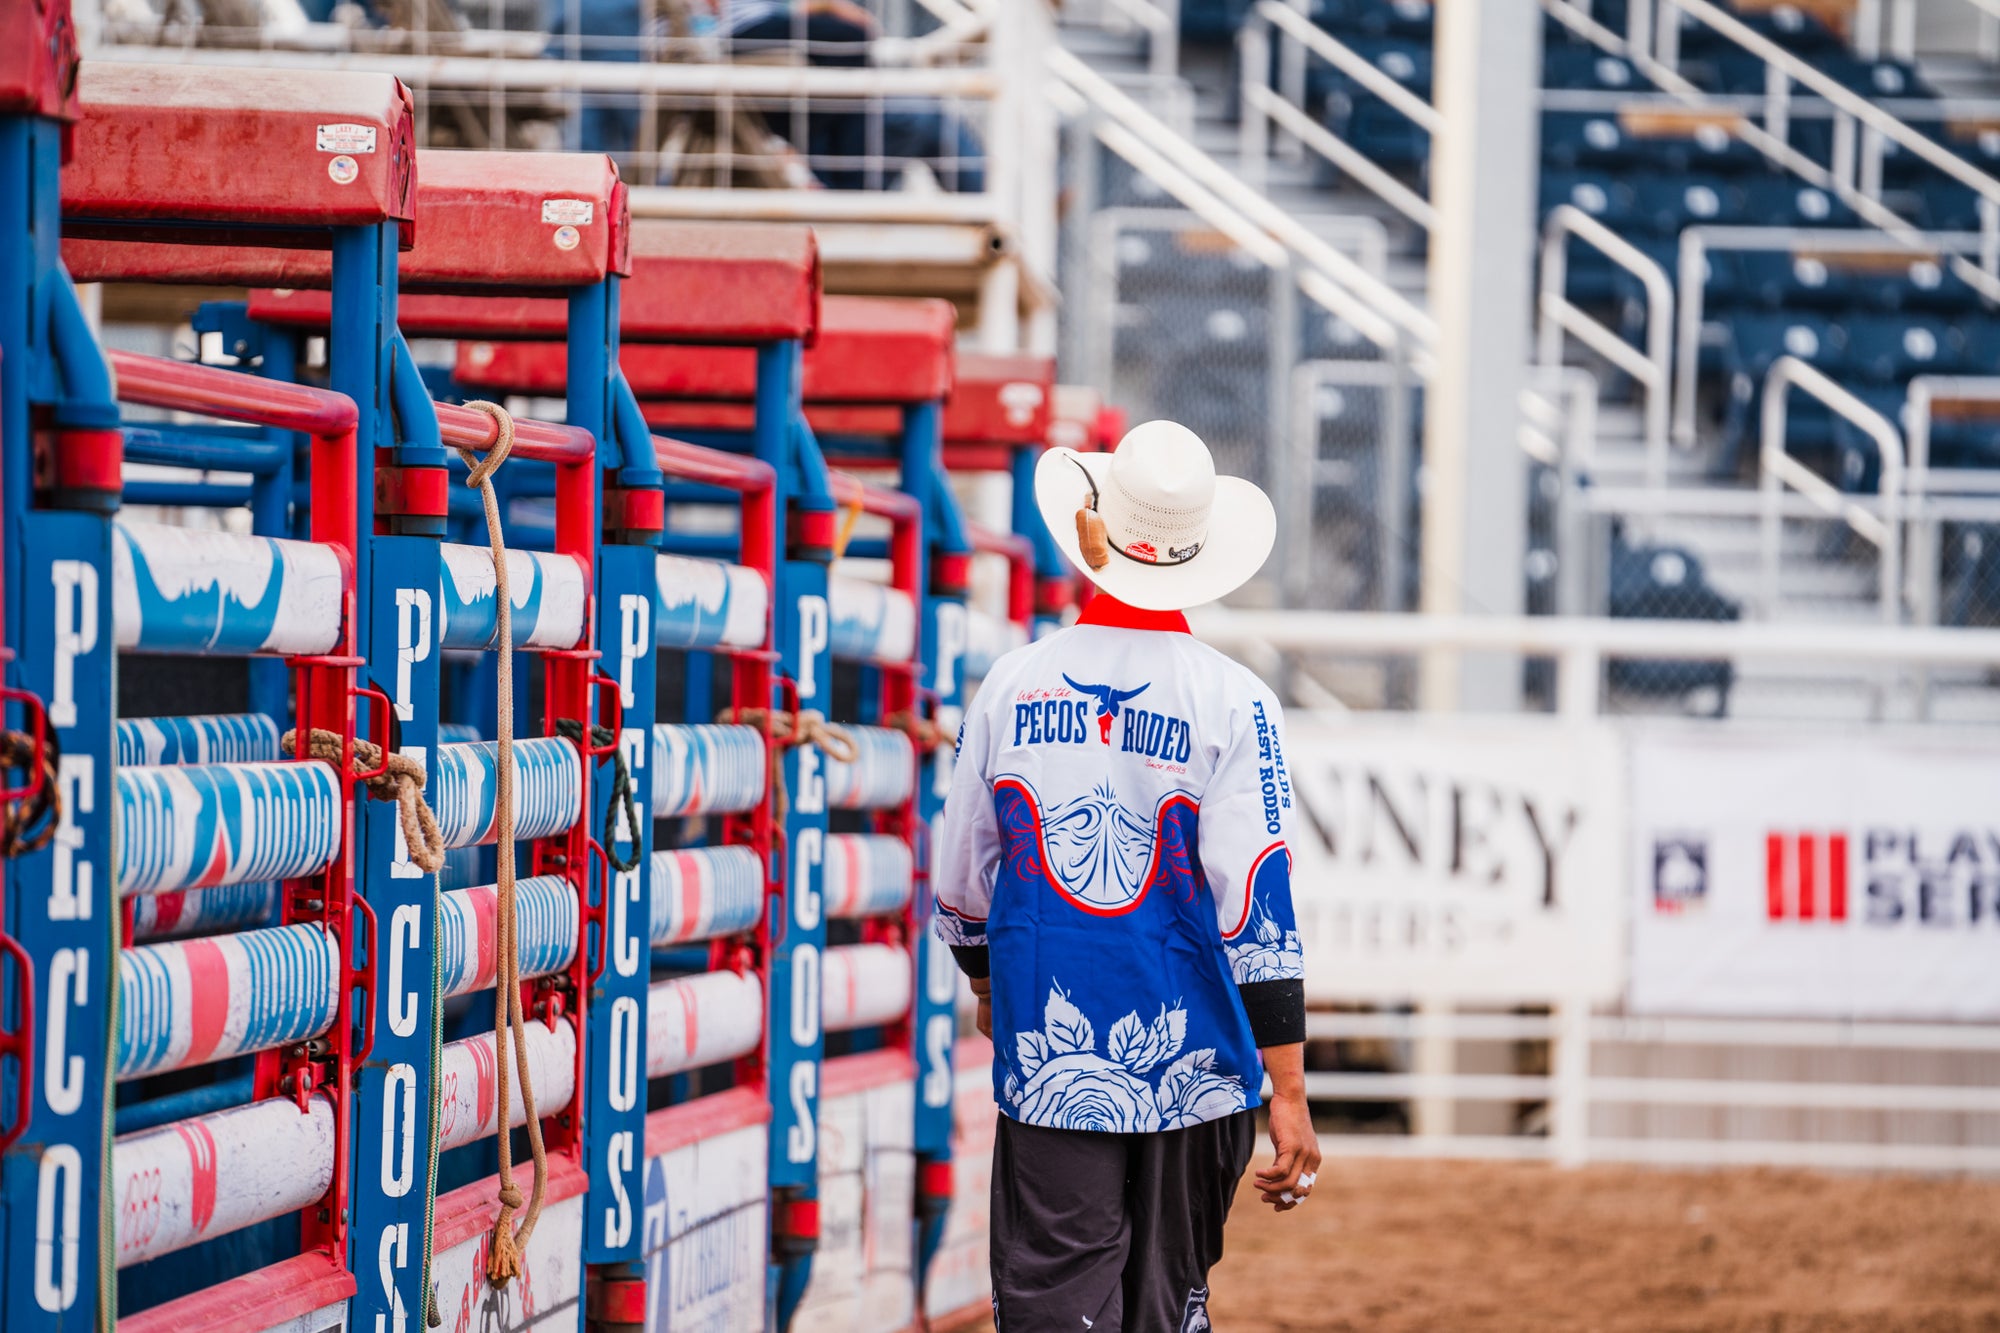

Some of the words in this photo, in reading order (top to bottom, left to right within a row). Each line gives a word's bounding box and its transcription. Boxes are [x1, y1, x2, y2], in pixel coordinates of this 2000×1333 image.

[1013, 700, 1088, 747] PECOS
[1121, 707, 1192, 764] RODEO
[1252, 700, 1272, 761] FIRST
[1270, 723, 1291, 809] WORLD'S
[1259, 766, 1281, 835] RODEO
[787, 595, 828, 1164] PECOS
[604, 594, 650, 1249] PECOS
